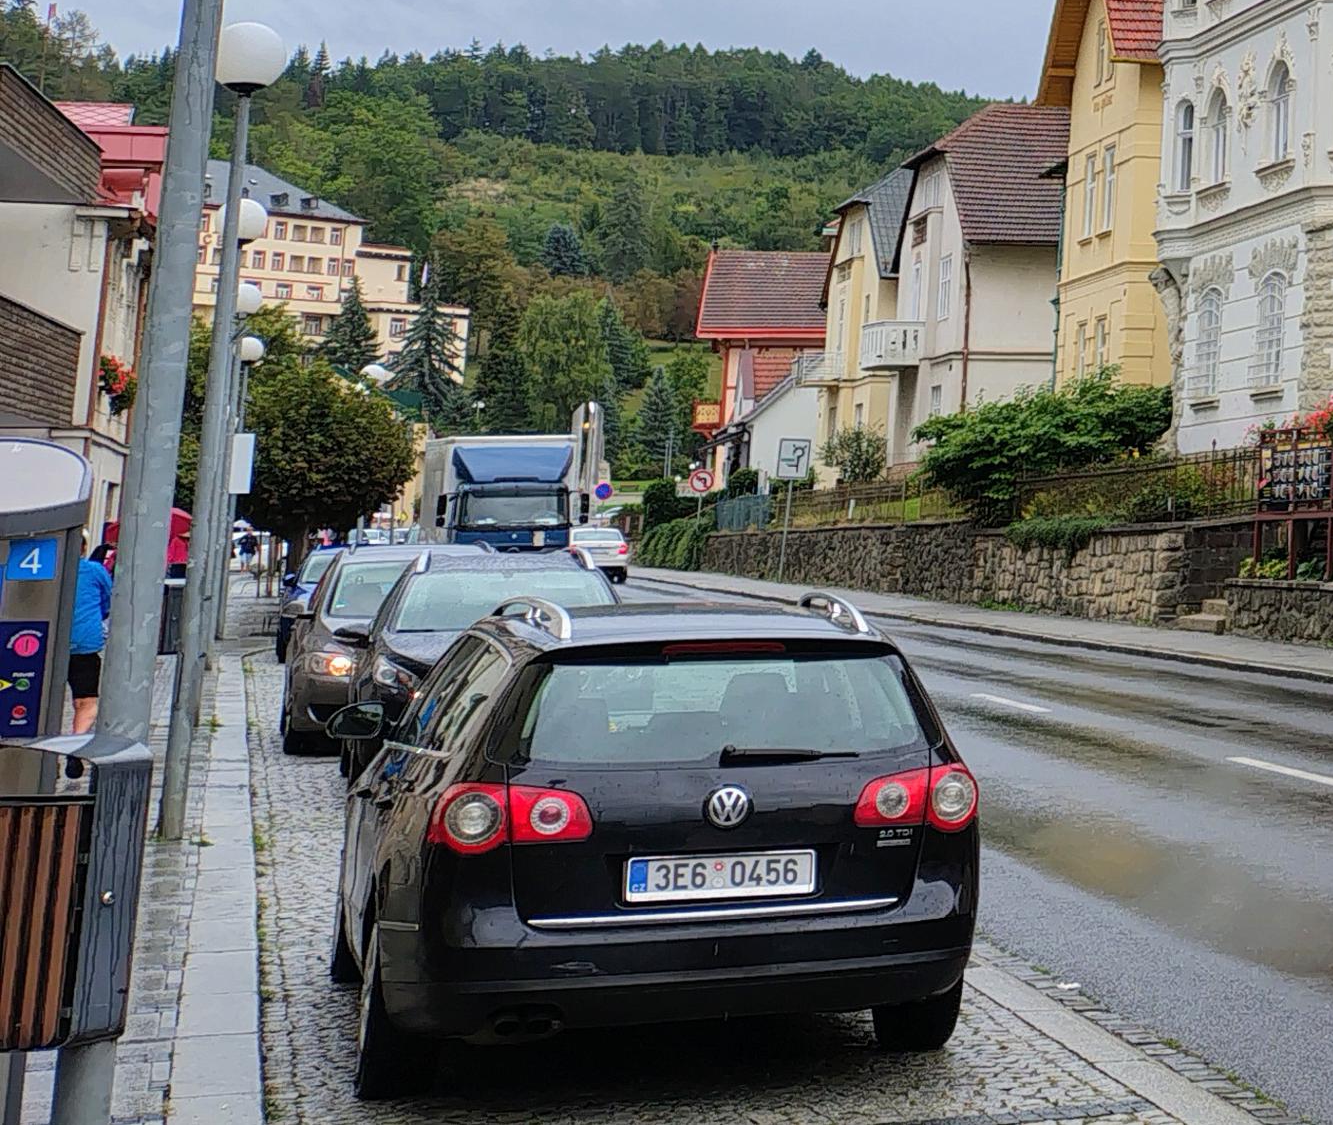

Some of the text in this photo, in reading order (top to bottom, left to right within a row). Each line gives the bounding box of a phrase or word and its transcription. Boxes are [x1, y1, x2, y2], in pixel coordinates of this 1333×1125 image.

[19, 547, 43, 574] 4
[896, 828, 914, 837] TDI
[653, 857, 799, 892] 3E6 0456
[631, 883, 647, 893] CZ
